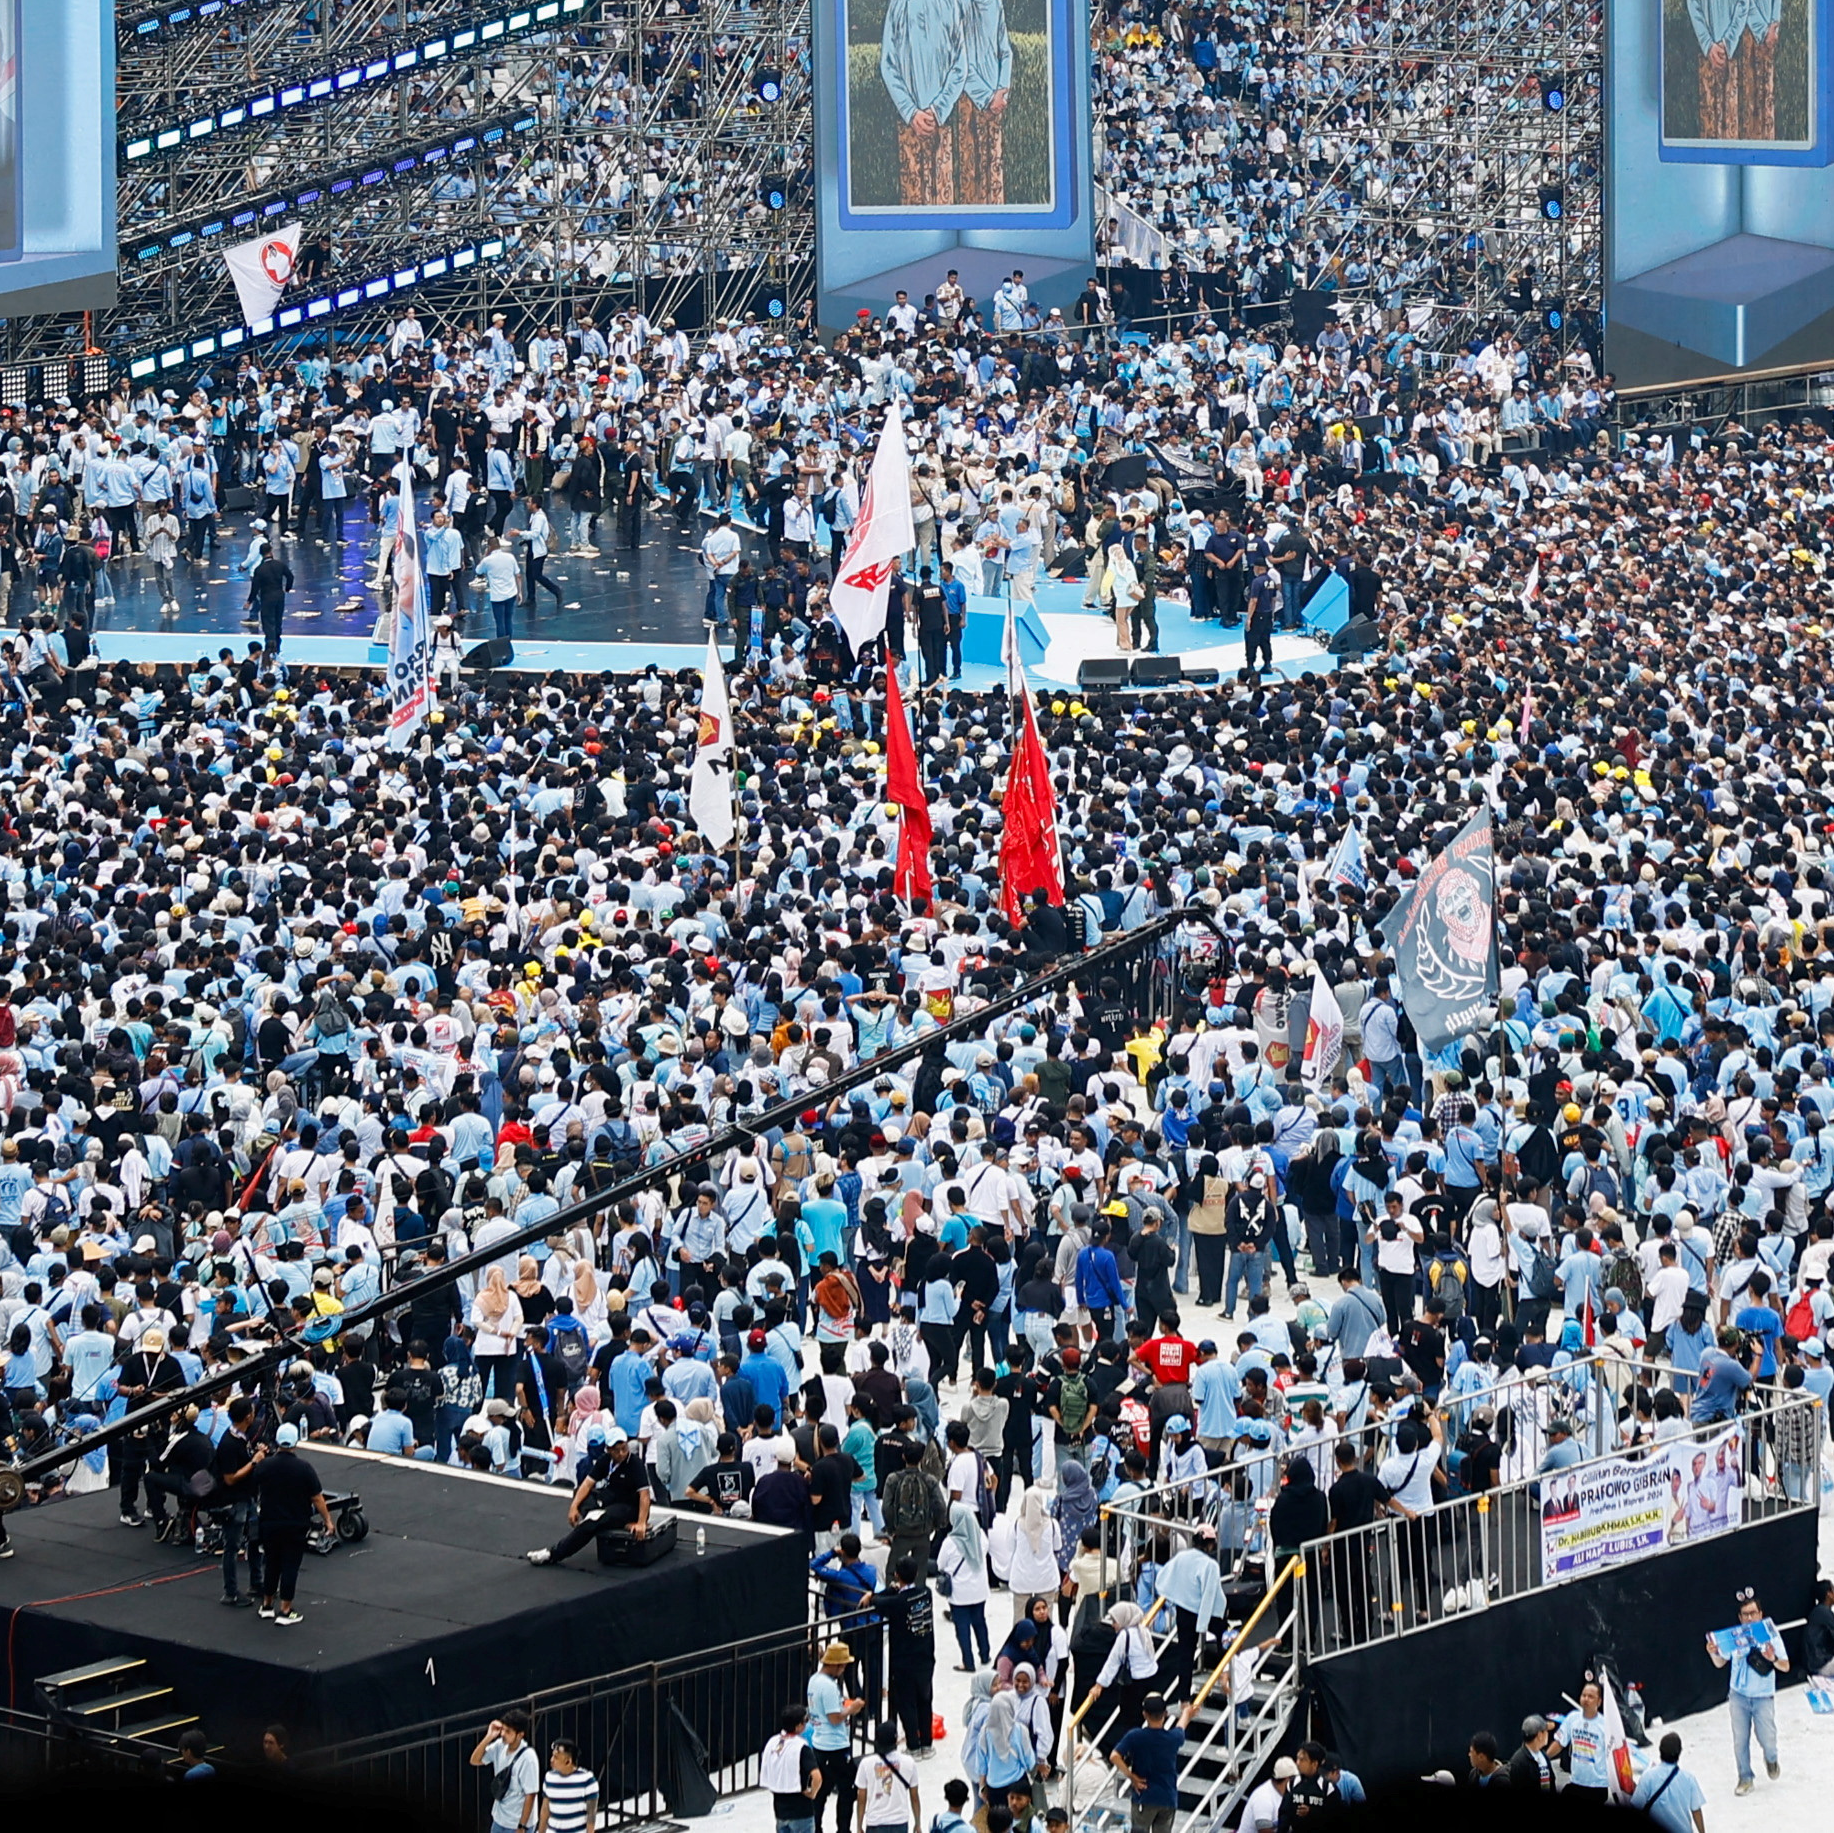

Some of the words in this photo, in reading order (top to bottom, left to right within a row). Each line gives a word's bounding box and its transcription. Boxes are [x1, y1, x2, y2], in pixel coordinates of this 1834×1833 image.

[1633, 1467, 1671, 1491] GIBRAN
[1558, 1535, 1571, 1548] Dr.
[1572, 1553, 1584, 1566] ALI
